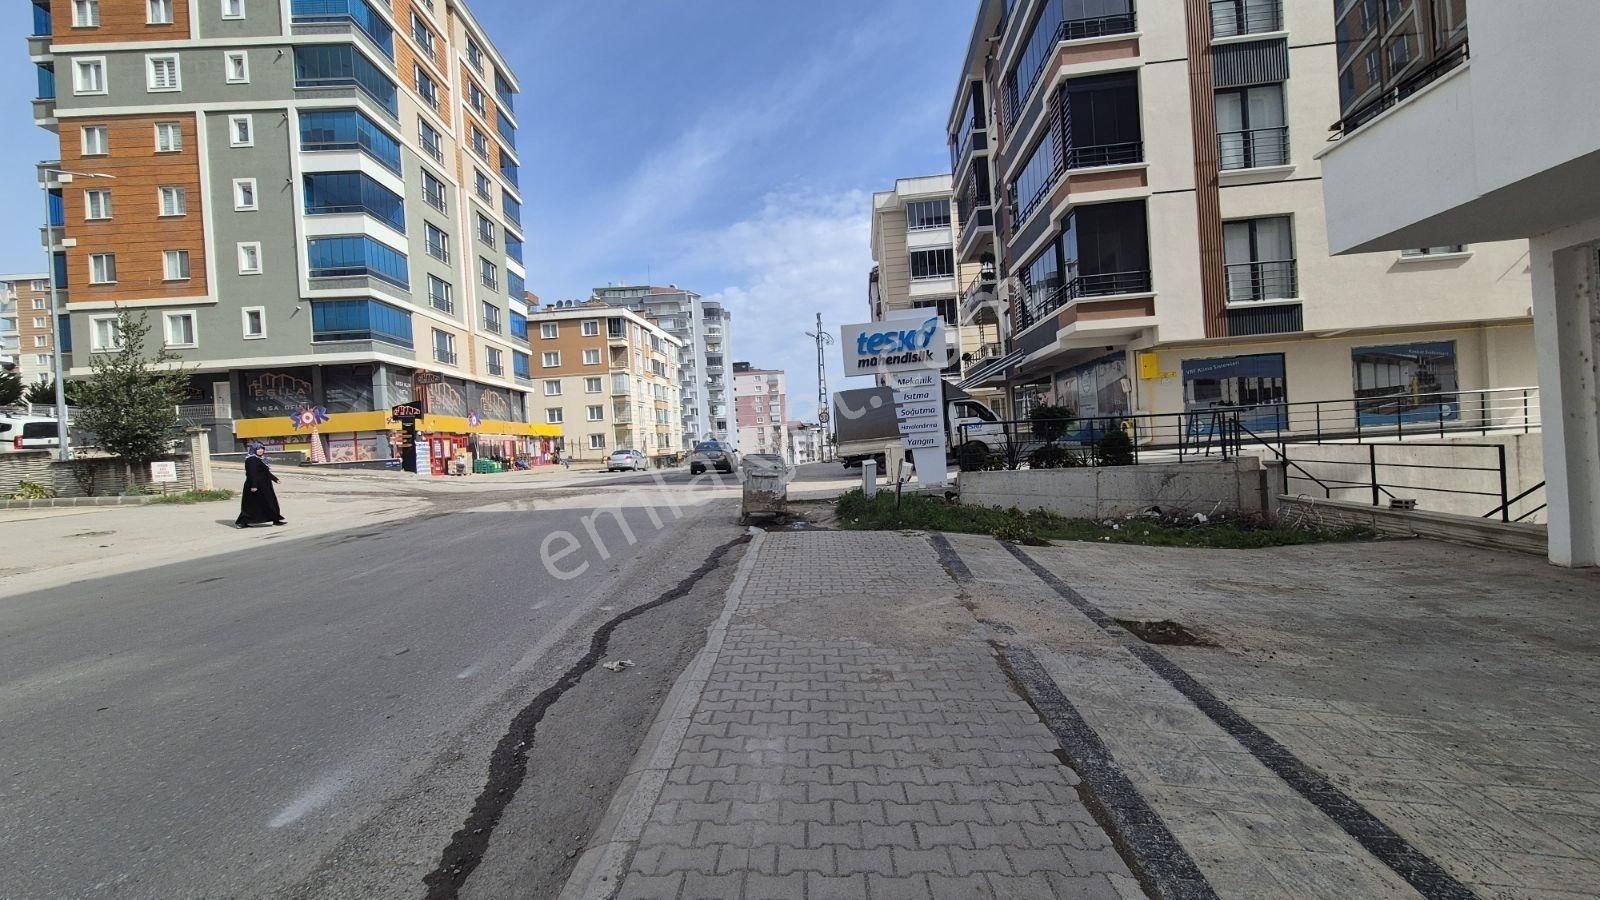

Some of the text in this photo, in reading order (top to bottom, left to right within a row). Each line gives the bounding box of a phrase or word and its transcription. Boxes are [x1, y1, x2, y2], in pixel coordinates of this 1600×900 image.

[897, 376, 933, 386] Mekanik
[900, 407, 936, 417] Soğutma
[907, 438, 934, 447] Yangın
